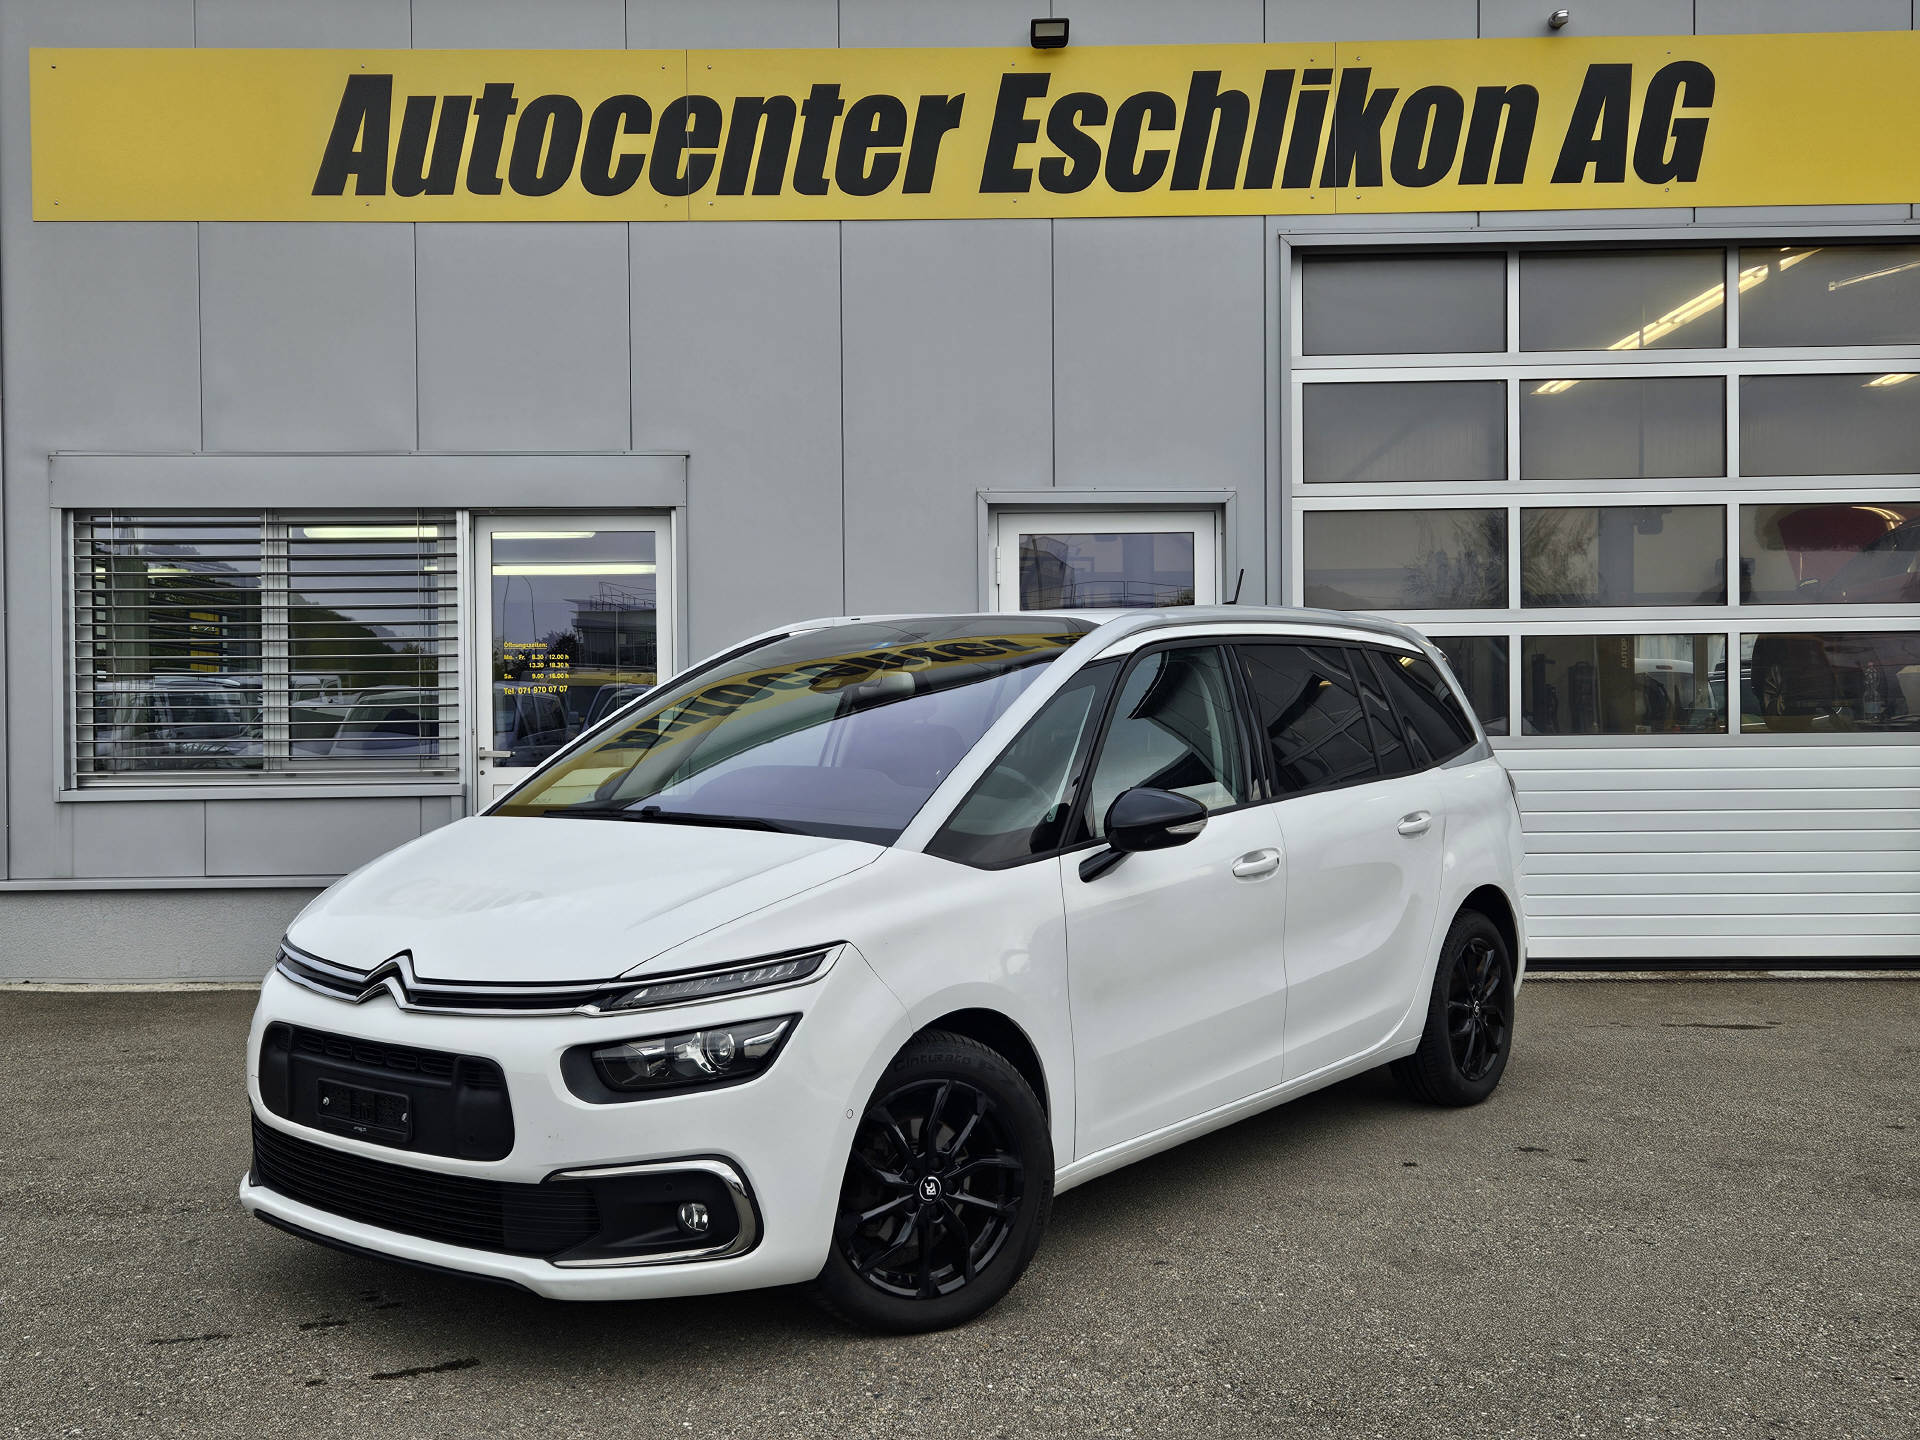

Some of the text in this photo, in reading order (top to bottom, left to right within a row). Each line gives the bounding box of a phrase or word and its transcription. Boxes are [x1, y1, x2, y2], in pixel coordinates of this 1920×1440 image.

[311, 60, 1716, 196] Autocenter Eschlikon AG
[533, 686, 547, 694] 970
[559, 685, 568, 693] 07
